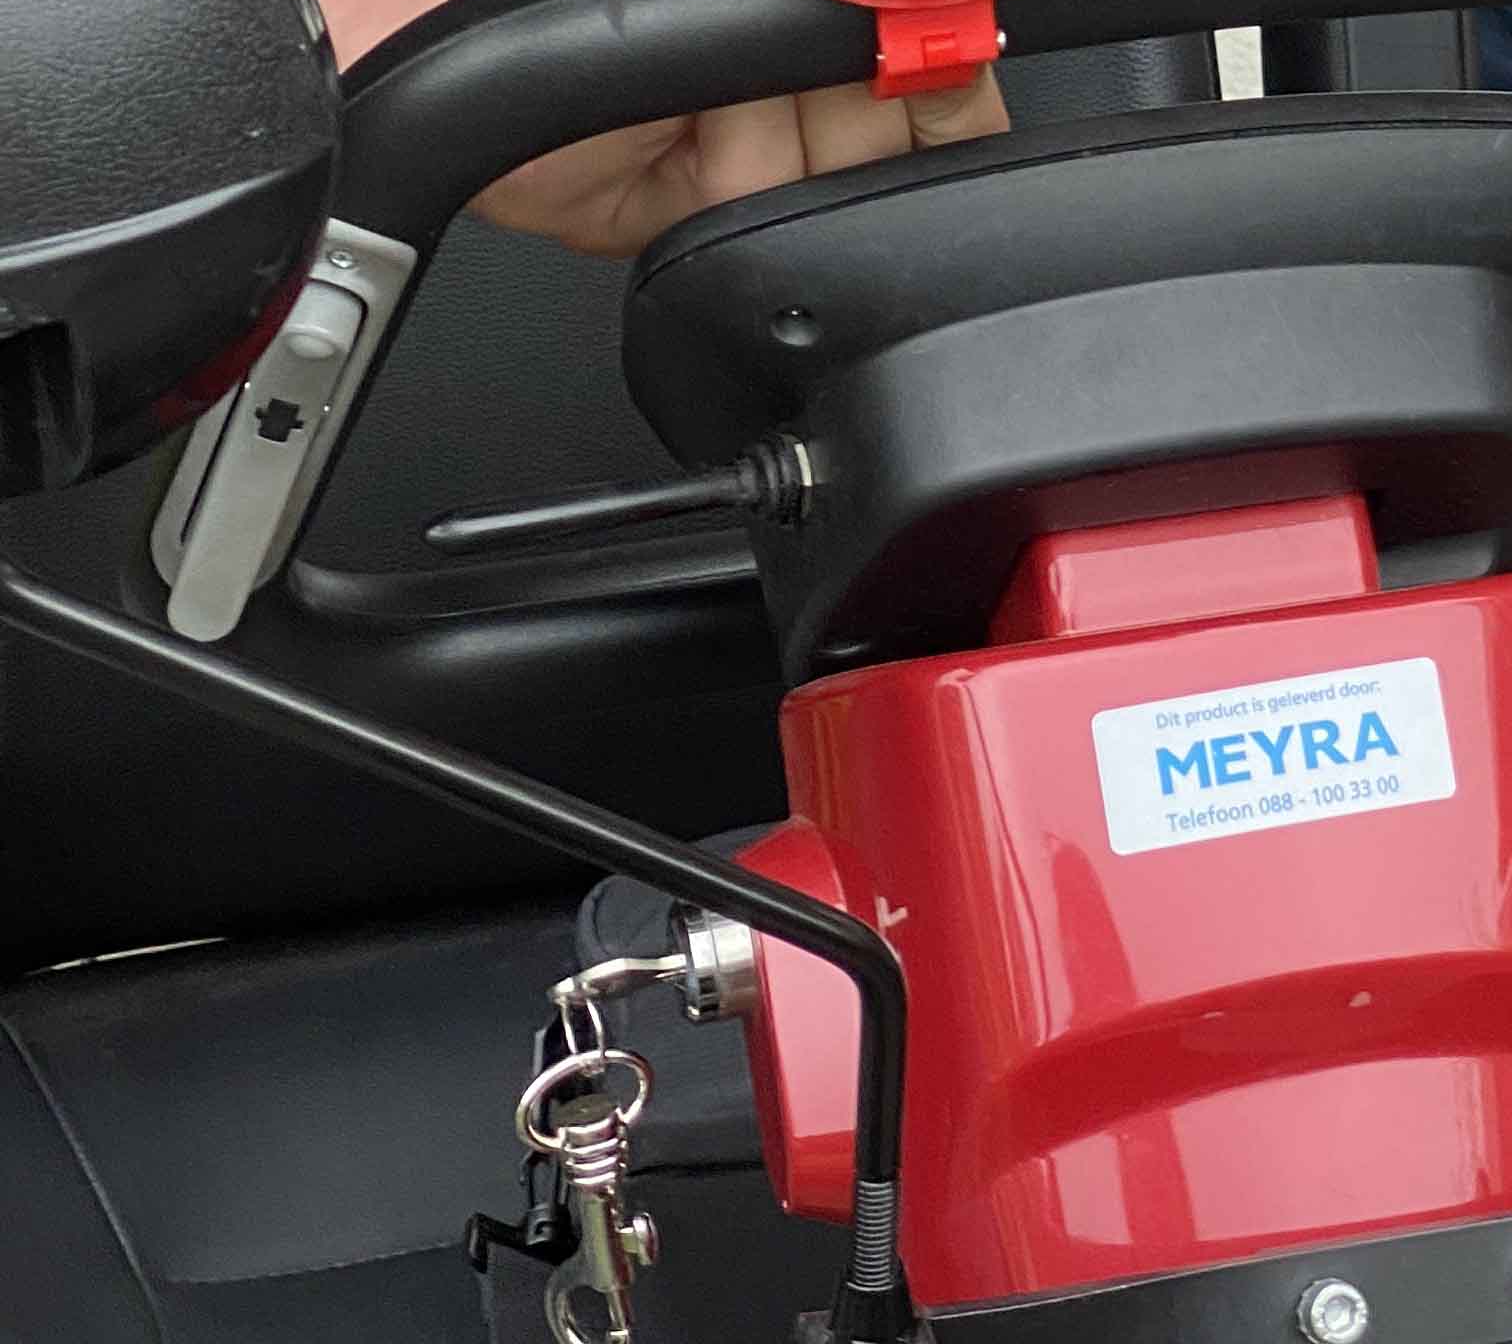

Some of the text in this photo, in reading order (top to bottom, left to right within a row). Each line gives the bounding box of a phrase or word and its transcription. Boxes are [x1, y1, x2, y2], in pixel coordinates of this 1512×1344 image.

[1155, 711, 1181, 729] Dit
[1185, 701, 1248, 728] product
[1251, 697, 1265, 713] is
[1267, 685, 1335, 713] geleverd
[1155, 710, 1400, 795] MEYRA
[1166, 802, 1255, 833] Telefoon
[1259, 791, 1293, 816] 088
[1312, 783, 1345, 804] 100
[1351, 778, 1372, 798] 33
[1376, 774, 1400, 794] 00
